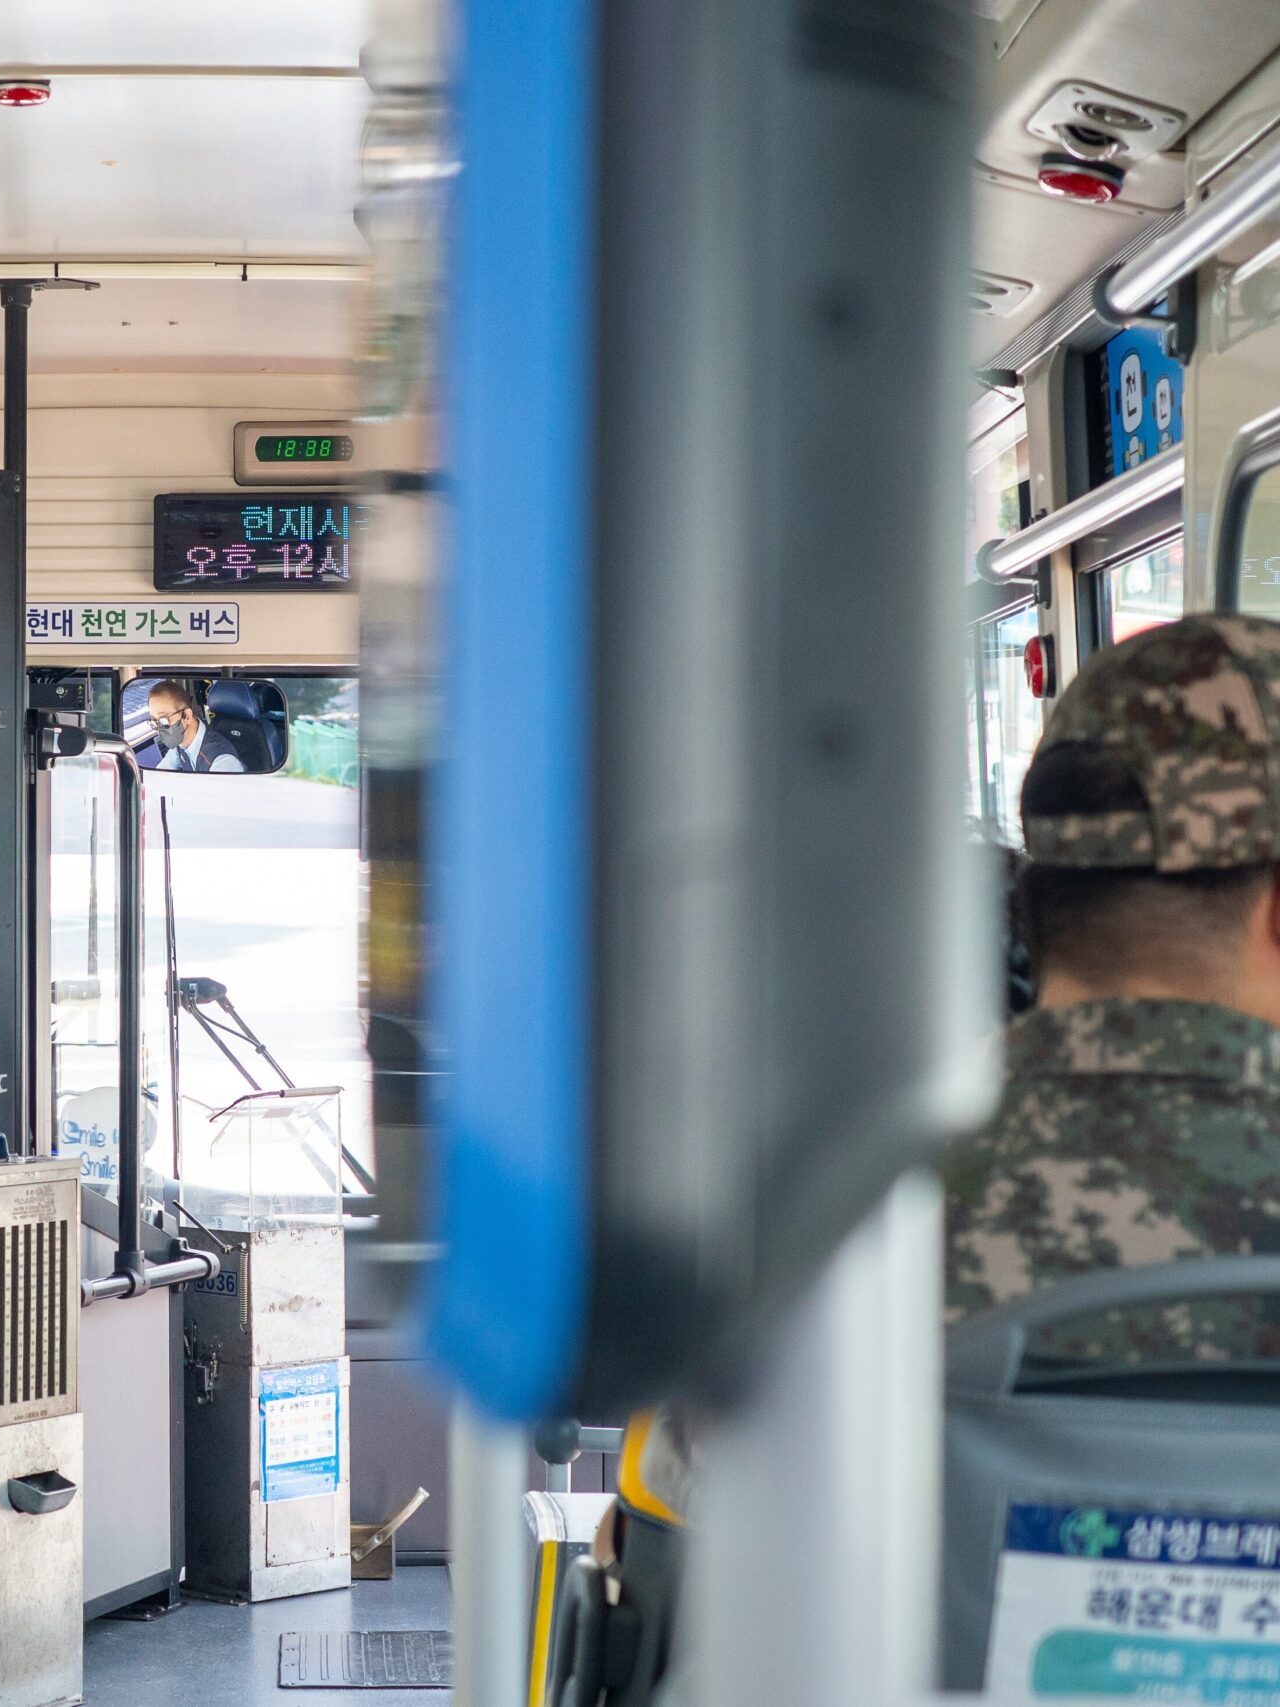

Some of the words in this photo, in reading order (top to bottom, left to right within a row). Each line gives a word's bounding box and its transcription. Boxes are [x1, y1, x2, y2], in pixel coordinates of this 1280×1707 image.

[185, 544, 256, 579] 오후
[273, 544, 349, 578] 12시
[27, 609, 73, 638] 현대
[80, 610, 128, 637] 천연
[135, 609, 181, 637] 가스
[189, 609, 236, 637] 버스
[61, 1121, 107, 1148] Smile
[80, 1152, 118, 1180] Smile
[1123, 1516, 1280, 1565] 삼성브레
[1087, 1585, 1222, 1633] 해운대
